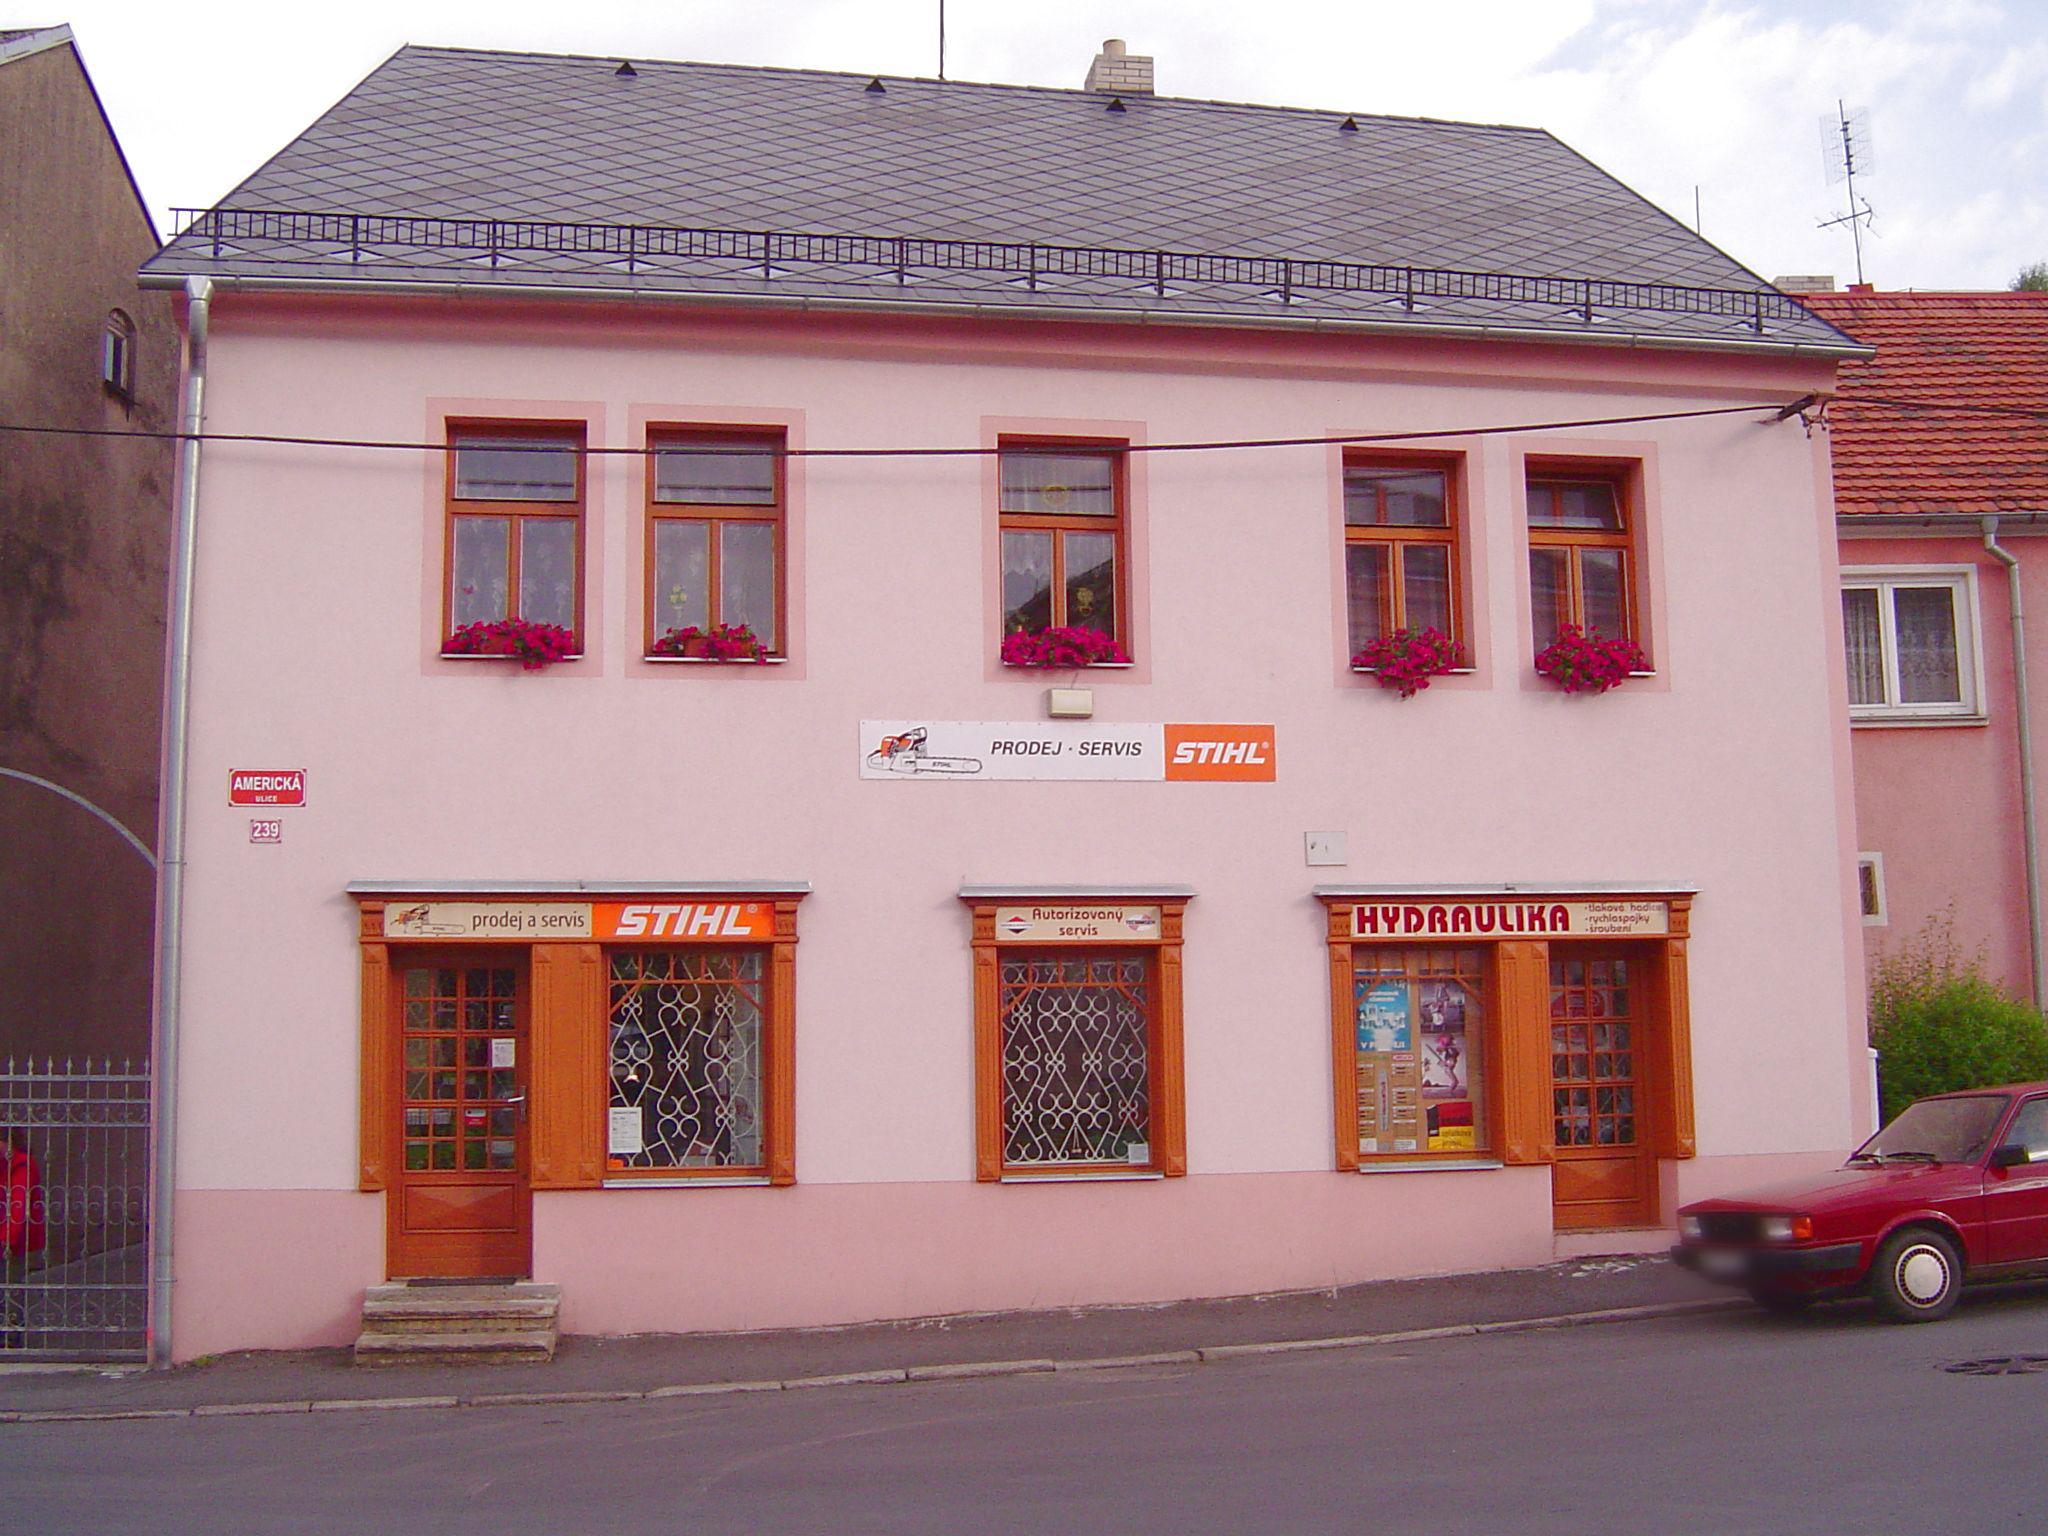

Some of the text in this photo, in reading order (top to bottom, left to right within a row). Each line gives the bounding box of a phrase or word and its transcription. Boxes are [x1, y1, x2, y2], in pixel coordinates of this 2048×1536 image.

[991, 741, 1142, 756] PRODEJ SERVIS
[1172, 742, 1265, 764] STIHL
[233, 773, 301, 790] AMERICKÁ
[253, 822, 279, 837] 239
[472, 911, 585, 931] prodej a servis
[616, 905, 751, 935] STIHL
[1032, 908, 1123, 922] Autorizovaný
[1357, 905, 1570, 933] HYDRAULIKA
[1059, 924, 1098, 936] servis
